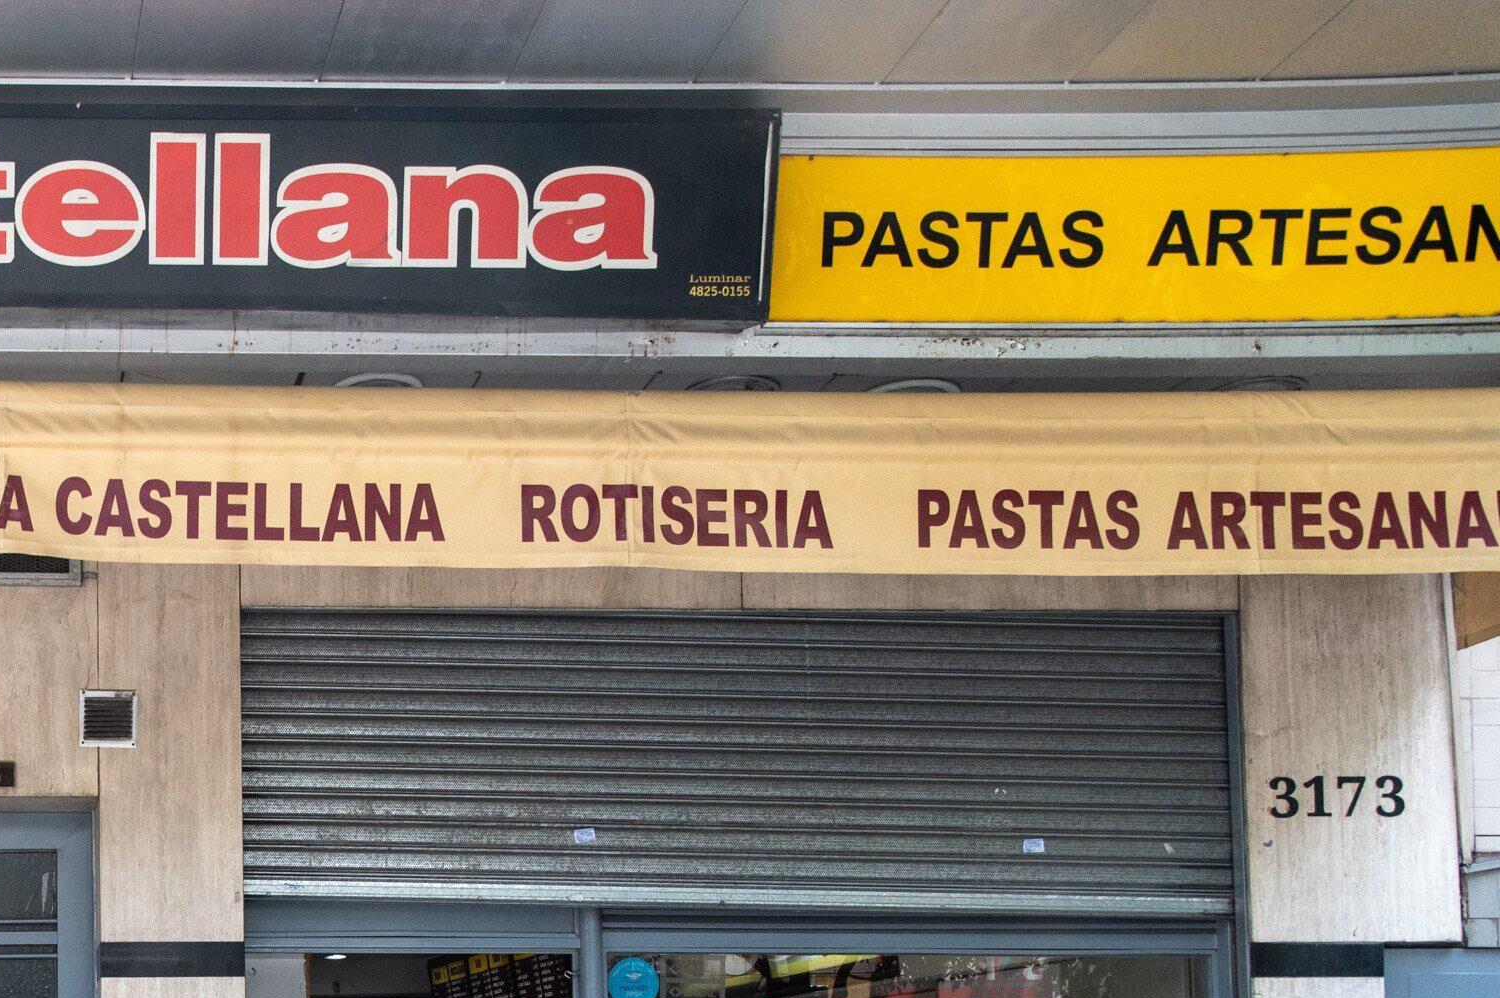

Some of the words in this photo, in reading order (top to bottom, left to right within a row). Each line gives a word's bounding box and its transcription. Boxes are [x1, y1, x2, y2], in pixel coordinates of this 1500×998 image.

[821, 210, 1105, 269] PASTAS
[689, 274, 751, 283] Luminar
[689, 286, 750, 296] 4825-0155
[54, 476, 446, 543] CASTELLANA
[521, 484, 834, 550] ROTISERIA
[917, 489, 1141, 550] PASTAS
[1167, 488, 1500, 551] ARTESANA
[1268, 775, 1406, 818] 3173
